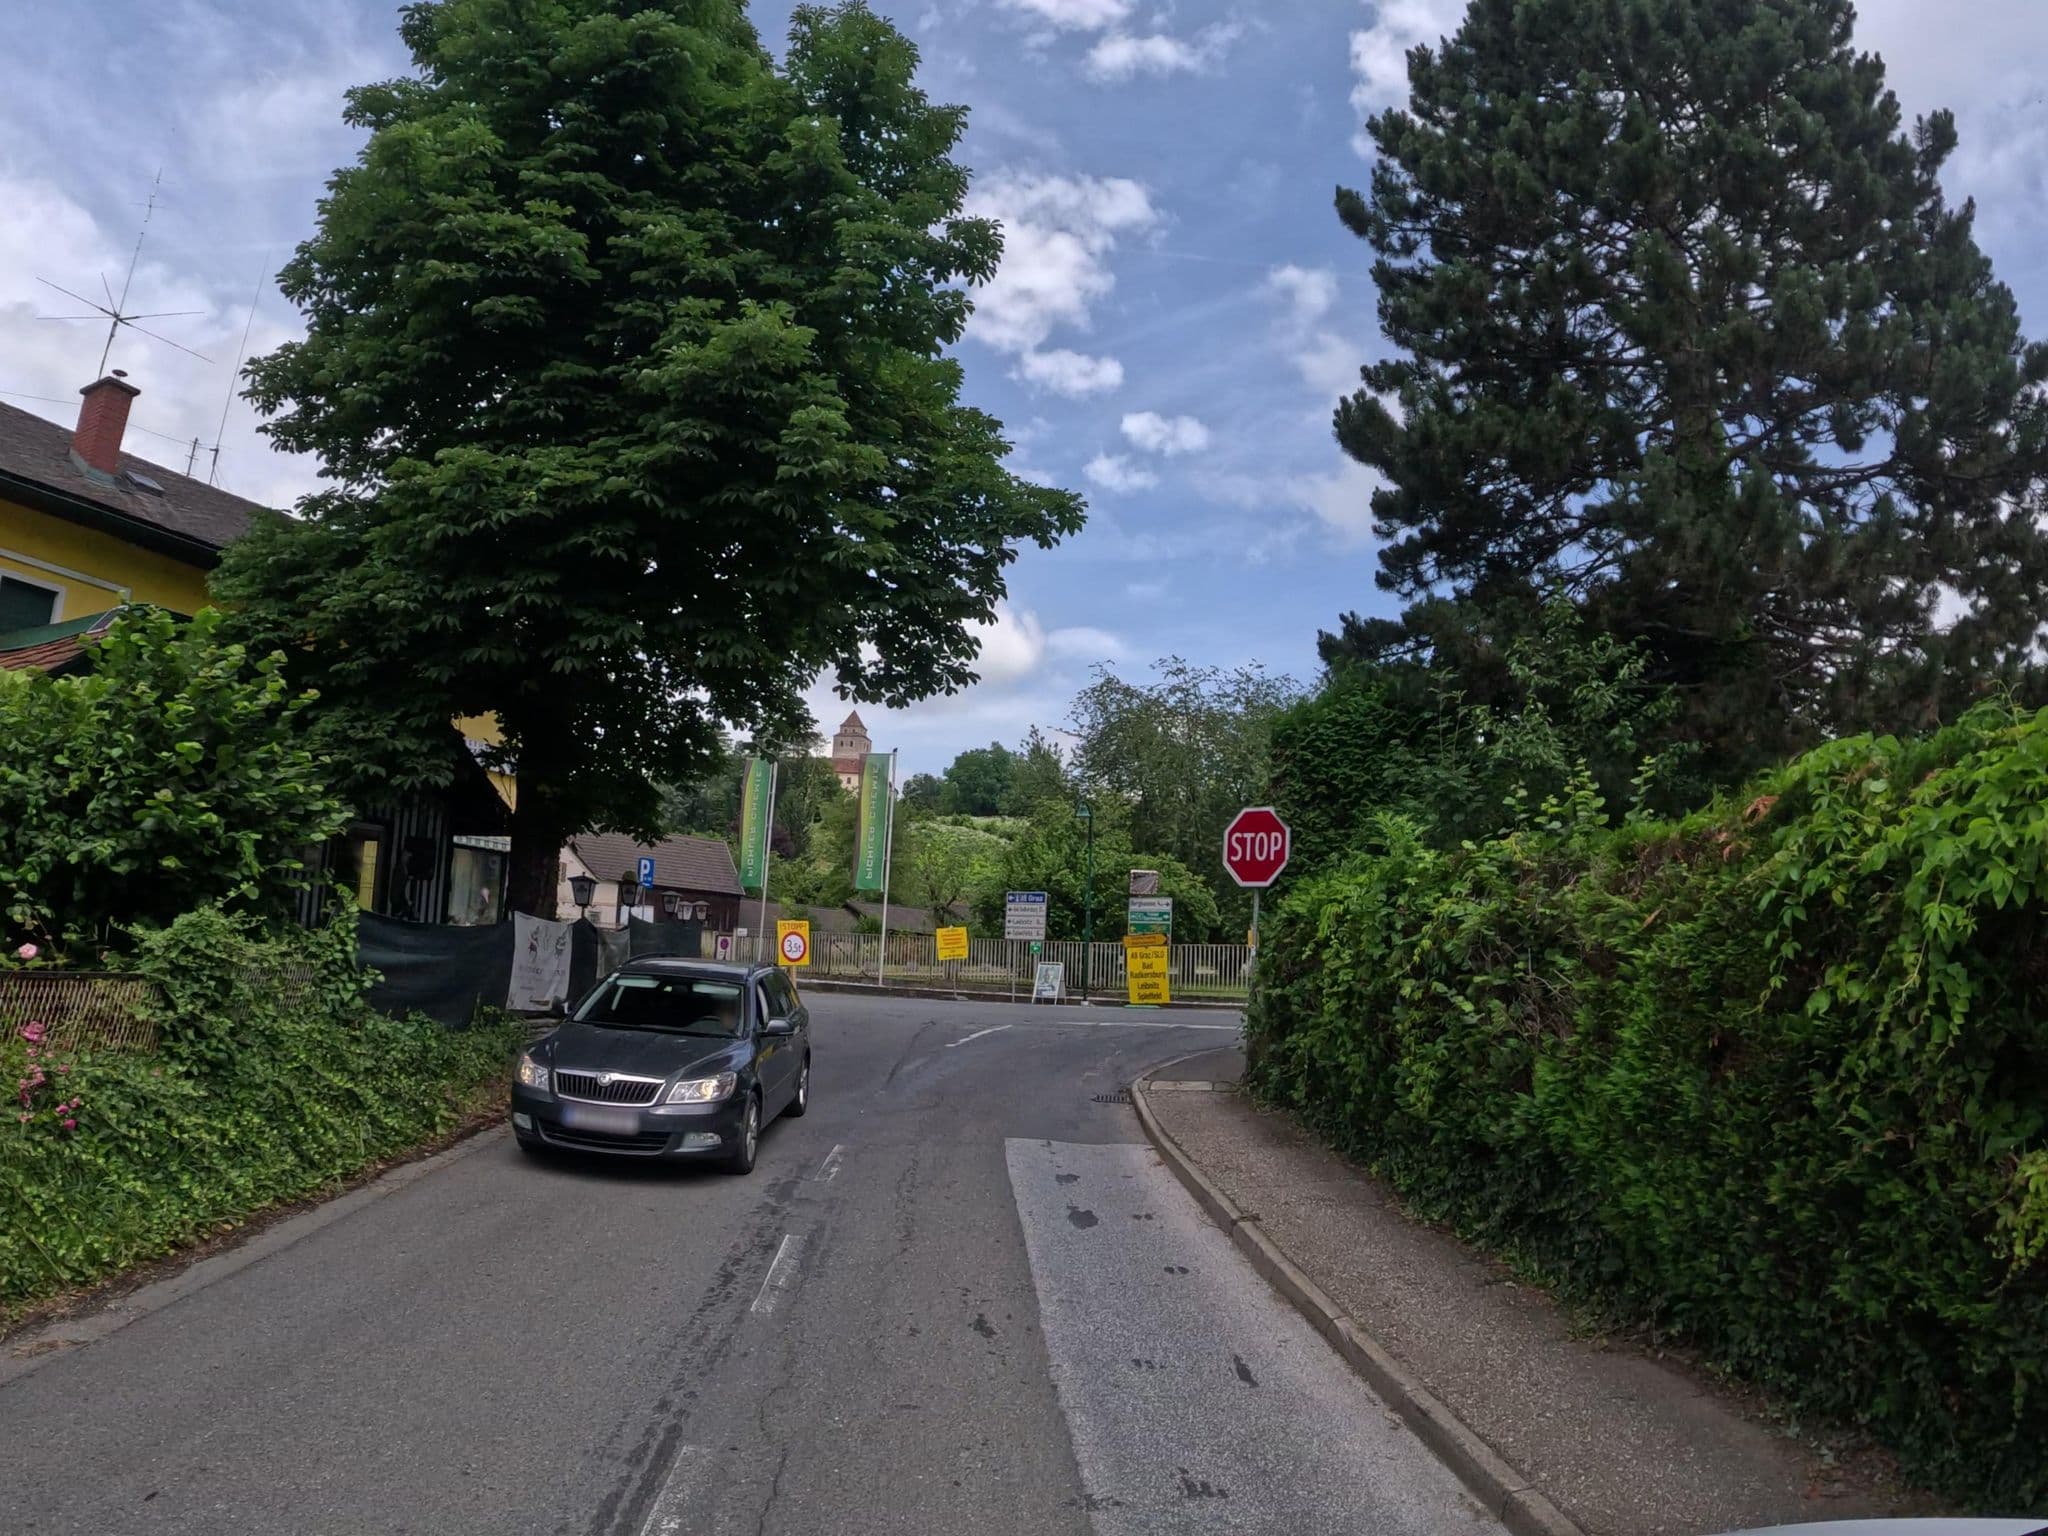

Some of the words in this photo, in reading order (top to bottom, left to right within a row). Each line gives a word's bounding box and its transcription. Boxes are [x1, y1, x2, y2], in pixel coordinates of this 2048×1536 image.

[1230, 831, 1283, 862] STOP
[640, 859, 650, 882] P
[1142, 961, 1153, 970] Bad
[1130, 970, 1166, 980] Radkersburg
[1137, 981, 1160, 990] Leibnitz
